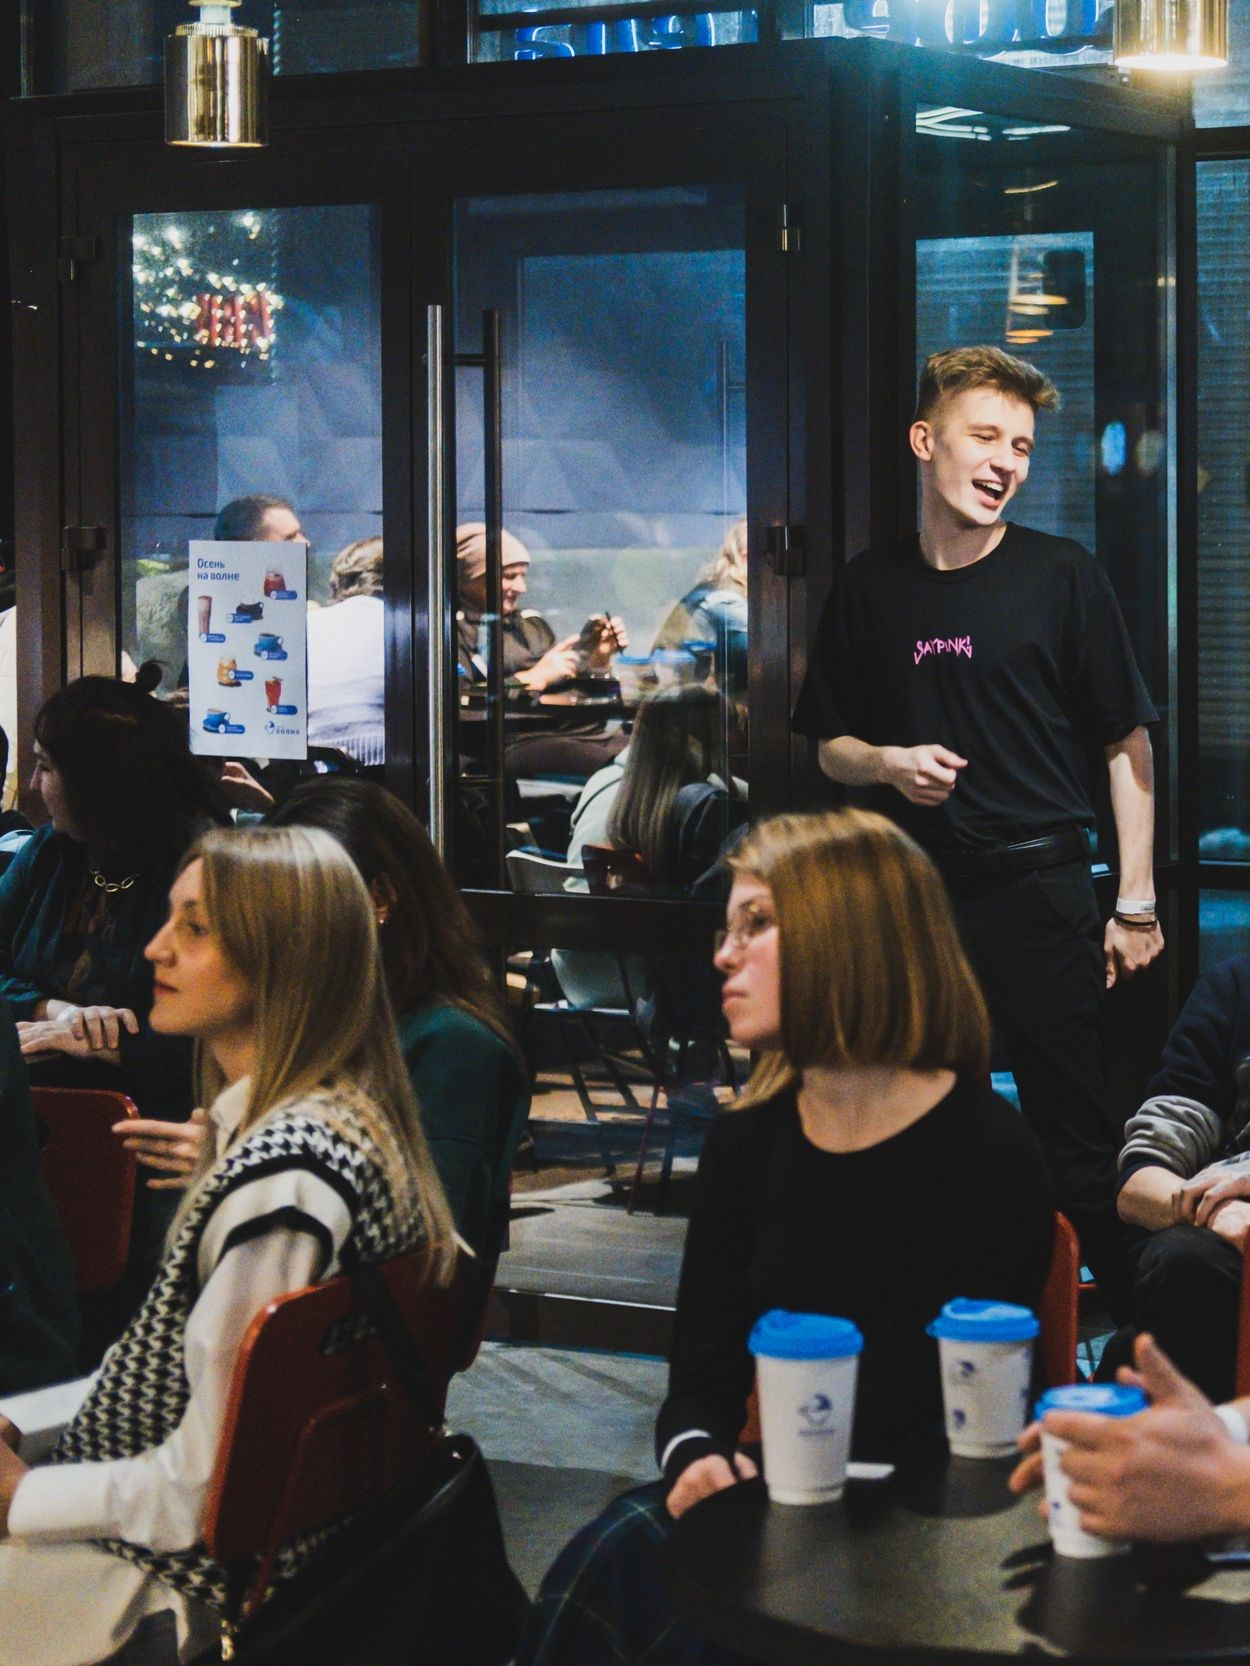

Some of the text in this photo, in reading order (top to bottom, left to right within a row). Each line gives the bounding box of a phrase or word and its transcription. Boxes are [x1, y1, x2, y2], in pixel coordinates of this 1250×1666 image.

[196, 558, 225, 569] Осень
[197, 572, 240, 581] на волне
